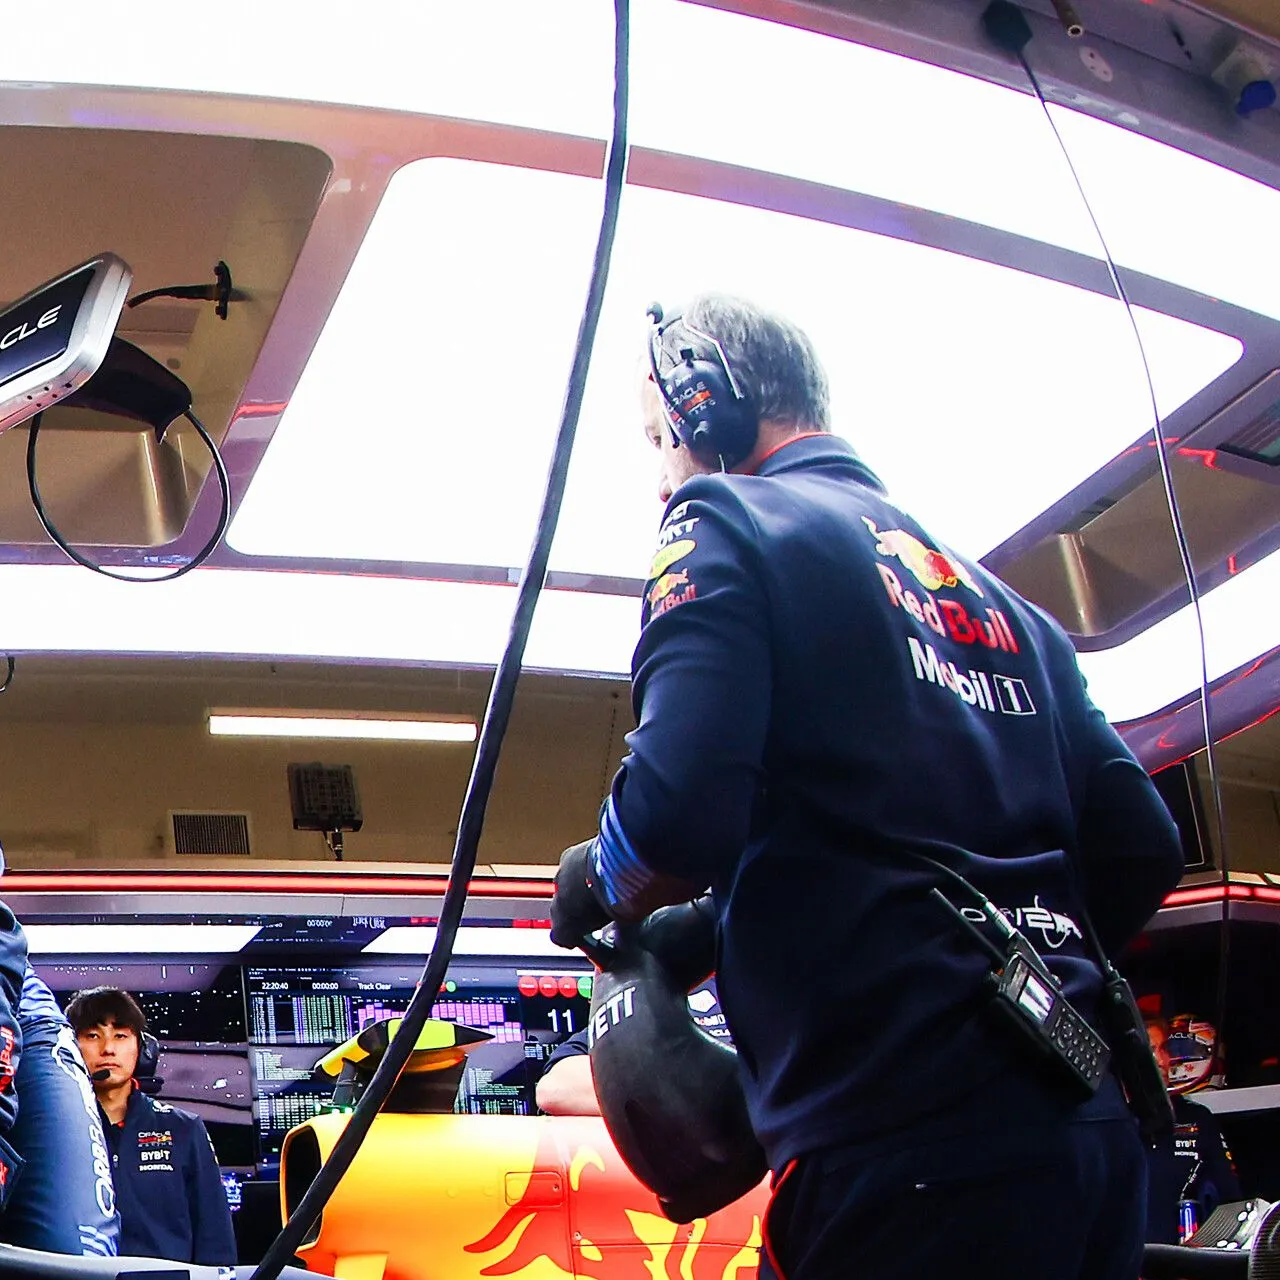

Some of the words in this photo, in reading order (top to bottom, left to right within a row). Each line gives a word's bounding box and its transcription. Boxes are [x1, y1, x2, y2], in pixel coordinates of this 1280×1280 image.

[876, 562, 946, 638] Red
[938, 599, 1020, 655] Bull
[907, 637, 995, 713] Mobil
[547, 1008, 574, 1034] 11
[590, 986, 635, 1049] YETI
[141, 1150, 171, 1162] BYBIT
